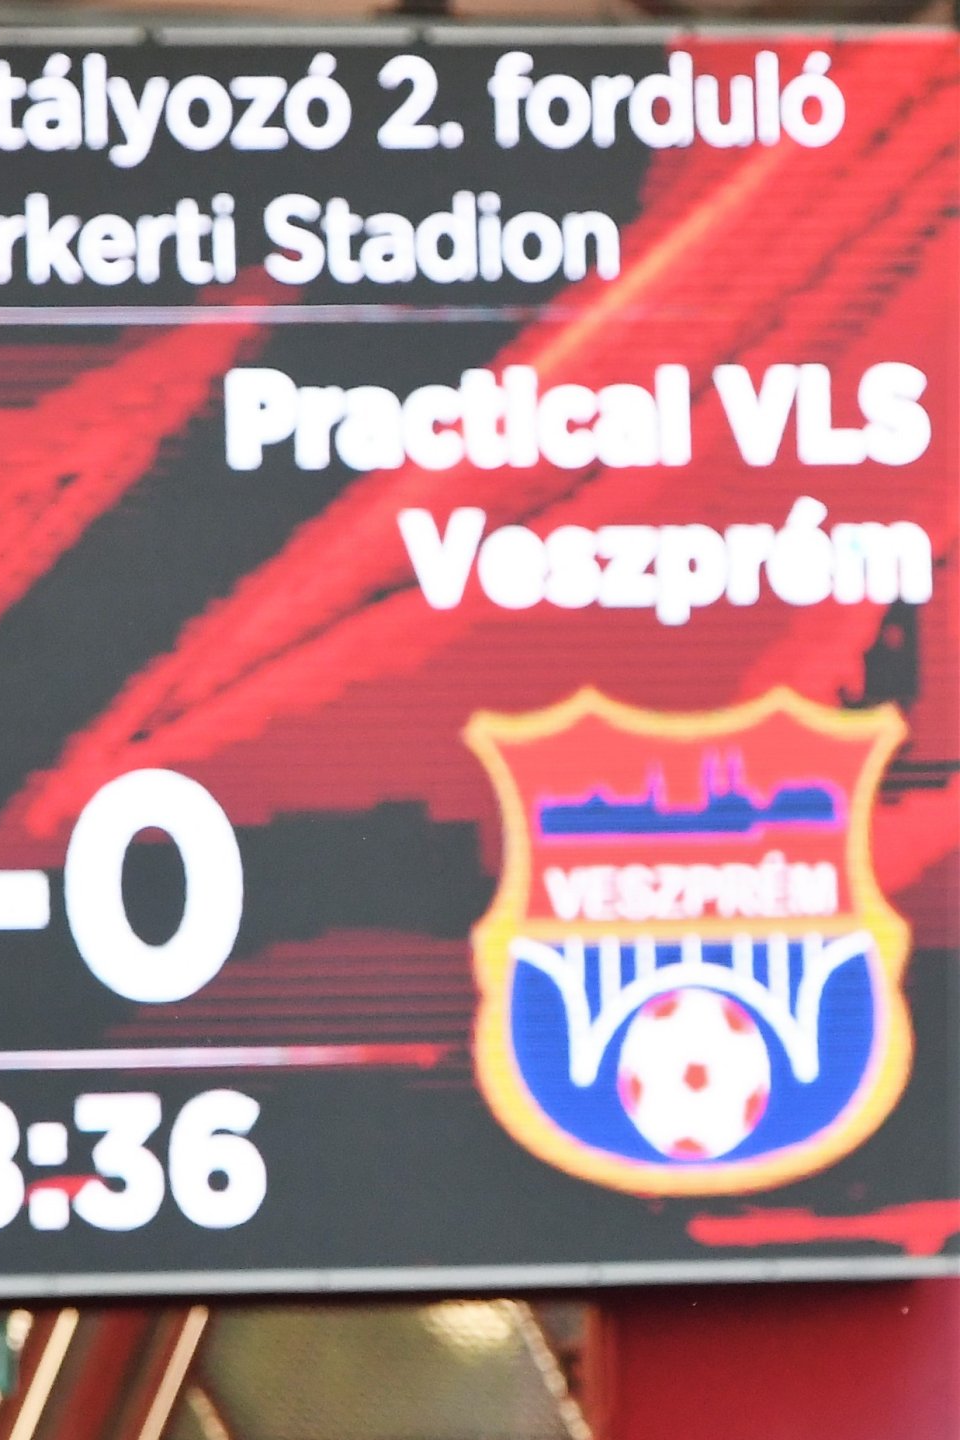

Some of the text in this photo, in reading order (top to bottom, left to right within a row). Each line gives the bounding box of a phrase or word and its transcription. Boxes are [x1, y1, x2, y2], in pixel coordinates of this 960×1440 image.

[377, 55, 464, 149] 2.
[488, 51, 845, 149] forduló
[264, 191, 620, 284] Stadion
[224, 363, 931, 471] Practical VLS
[398, 496, 933, 624] Veszprém
[543, 849, 839, 920] VESZPRÉM
